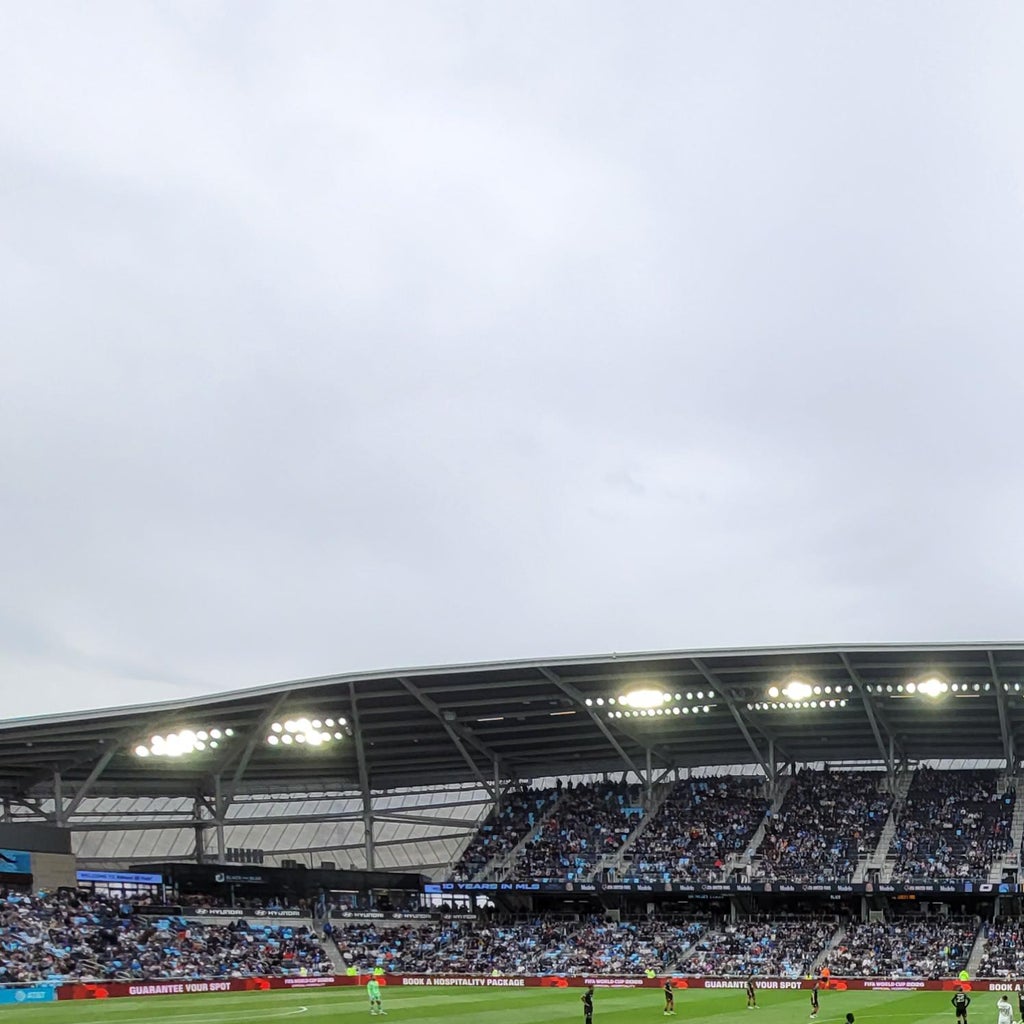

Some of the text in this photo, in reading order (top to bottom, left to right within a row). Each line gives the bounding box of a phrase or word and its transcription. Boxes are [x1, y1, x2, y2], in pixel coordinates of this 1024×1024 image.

[402, 977, 424, 985] BOOK
[434, 978, 485, 986] HOSPITALITY
[487, 978, 525, 986] PACKAGE
[704, 980, 802, 989] GUARANTE YOUR SPOT
[128, 981, 231, 995] GUARANTEE YOUR SPOT
[989, 983, 1013, 991] BOOK
[1014, 983, 1021, 991] A
